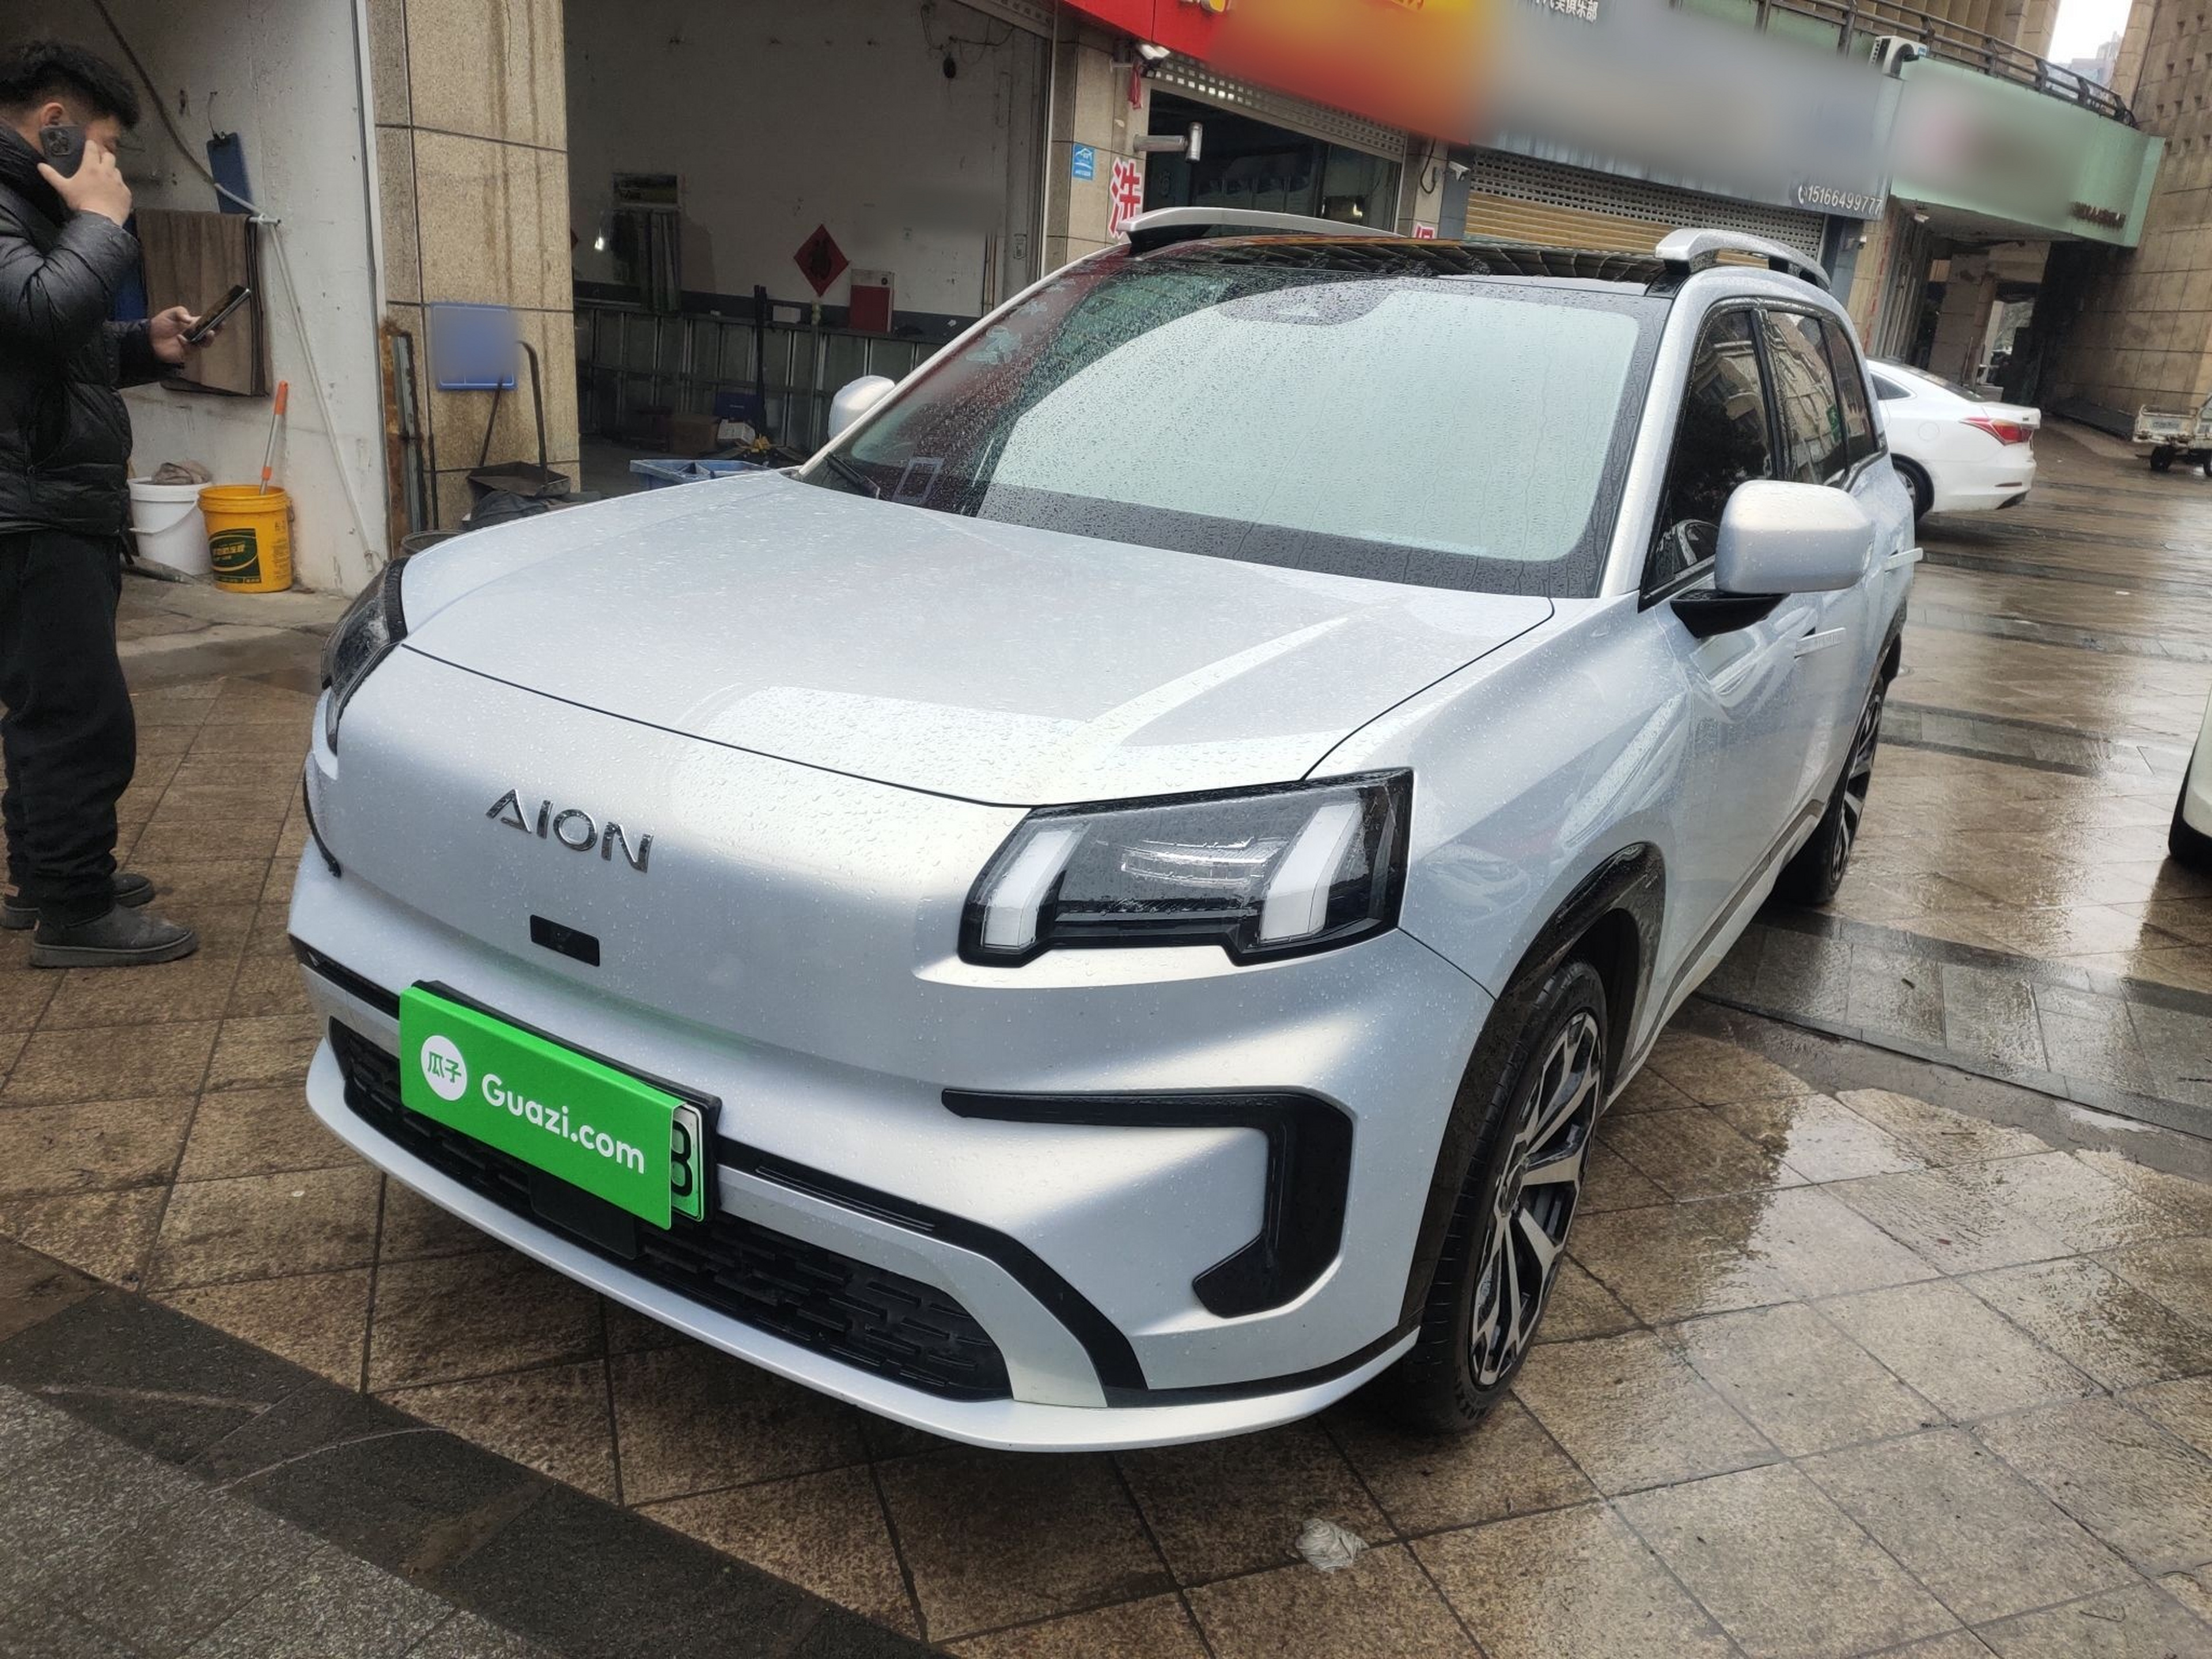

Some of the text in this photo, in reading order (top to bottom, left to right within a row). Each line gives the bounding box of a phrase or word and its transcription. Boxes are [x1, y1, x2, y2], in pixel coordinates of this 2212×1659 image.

[1109, 158, 1142, 238] 洗
[1808, 184, 1883, 215] 15166499777
[486, 789, 654, 873] AION
[427, 1051, 462, 1083] 瓜子
[481, 1073, 645, 1175] Guazi.com
